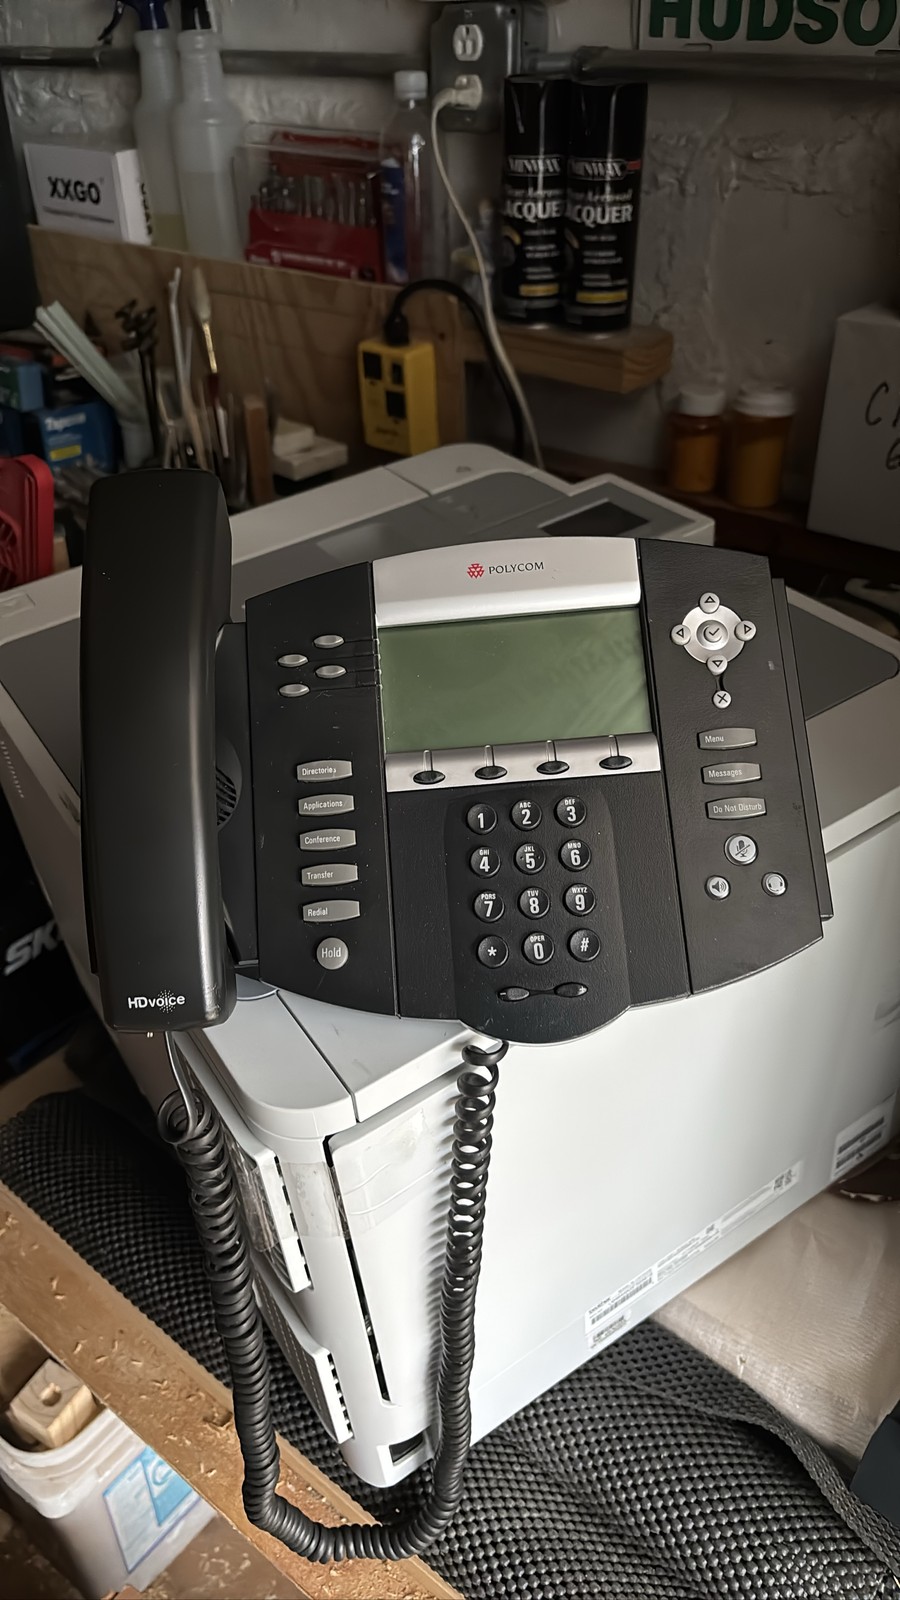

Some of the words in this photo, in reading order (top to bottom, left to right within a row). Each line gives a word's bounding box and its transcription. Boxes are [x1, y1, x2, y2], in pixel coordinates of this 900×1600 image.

[648, 0, 900, 46] HUDSO
[47, 176, 102, 205] XXGO
[504, 199, 562, 223] ACQUE
[488, 561, 544, 575] POLYCOM
[704, 735, 725, 743] Menu
[708, 769, 743, 778] Messages
[303, 800, 343, 811] Applications
[566, 805, 577, 822] 3
[713, 805, 723, 814] Do
[724, 804, 737, 812] Not
[738, 803, 762, 811] Disturb
[477, 813, 485, 829] 1
[521, 809, 532, 825] 2
[304, 835, 340, 845] Conference
[479, 856, 490, 873] 4
[525, 852, 536, 869] 5
[570, 849, 581, 866] 6
[307, 870, 334, 880] Transfer
[484, 900, 494, 918] 7
[529, 897, 540, 914] 8
[574, 894, 586, 911] 9
[307, 907, 328, 917] Redial
[529, 935, 546, 943] OPER
[580, 937, 590, 952] #
[3, 919, 62, 976] SK
[321, 947, 342, 958] Hold
[533, 942, 544, 960] 0
